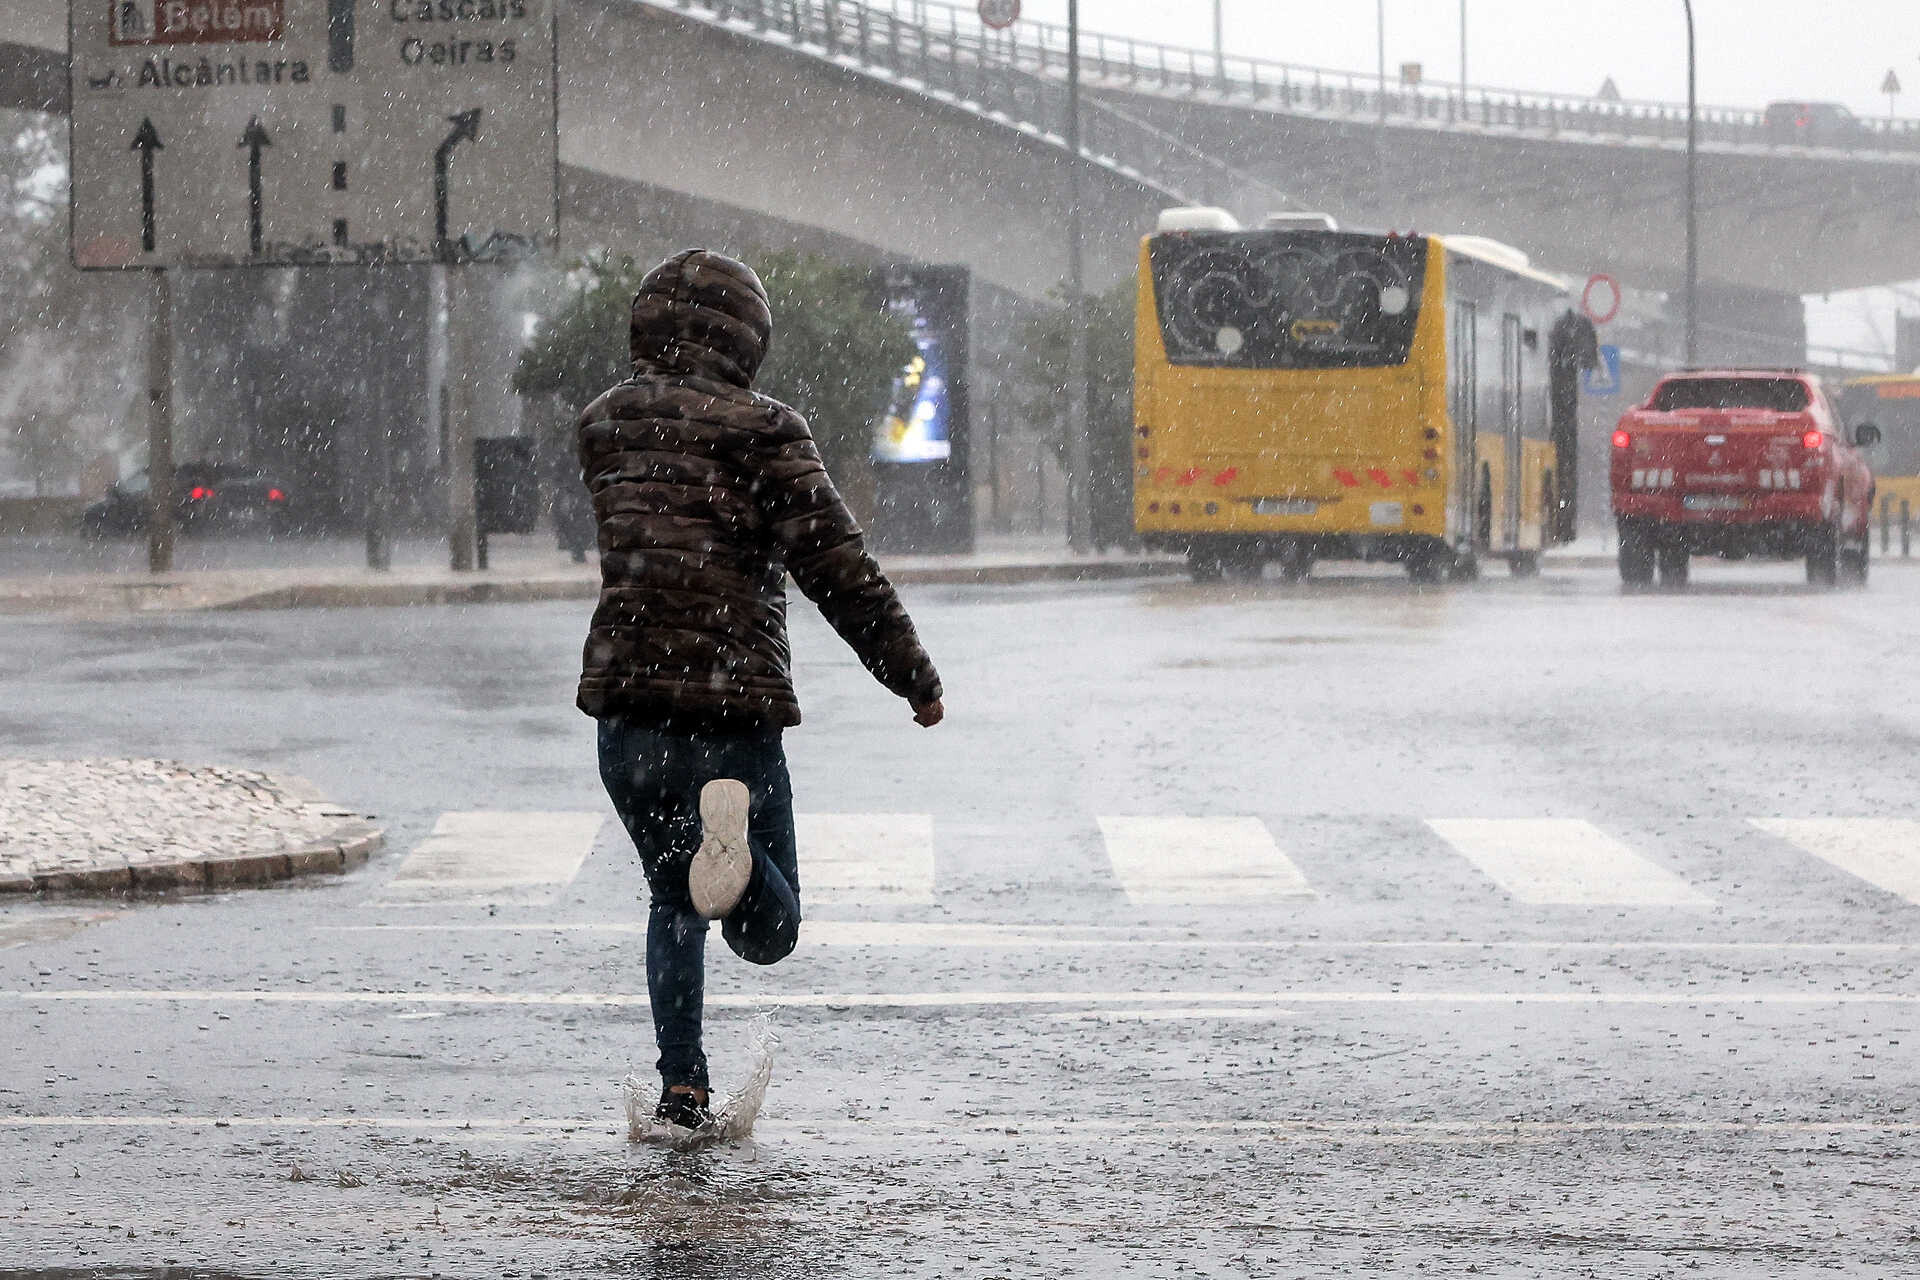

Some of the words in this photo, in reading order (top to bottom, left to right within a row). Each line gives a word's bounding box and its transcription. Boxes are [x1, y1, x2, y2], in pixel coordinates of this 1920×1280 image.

[390, 0, 526, 22] Cascais
[401, 34, 516, 66] Oeiras
[138, 55, 310, 88] Alcântara
